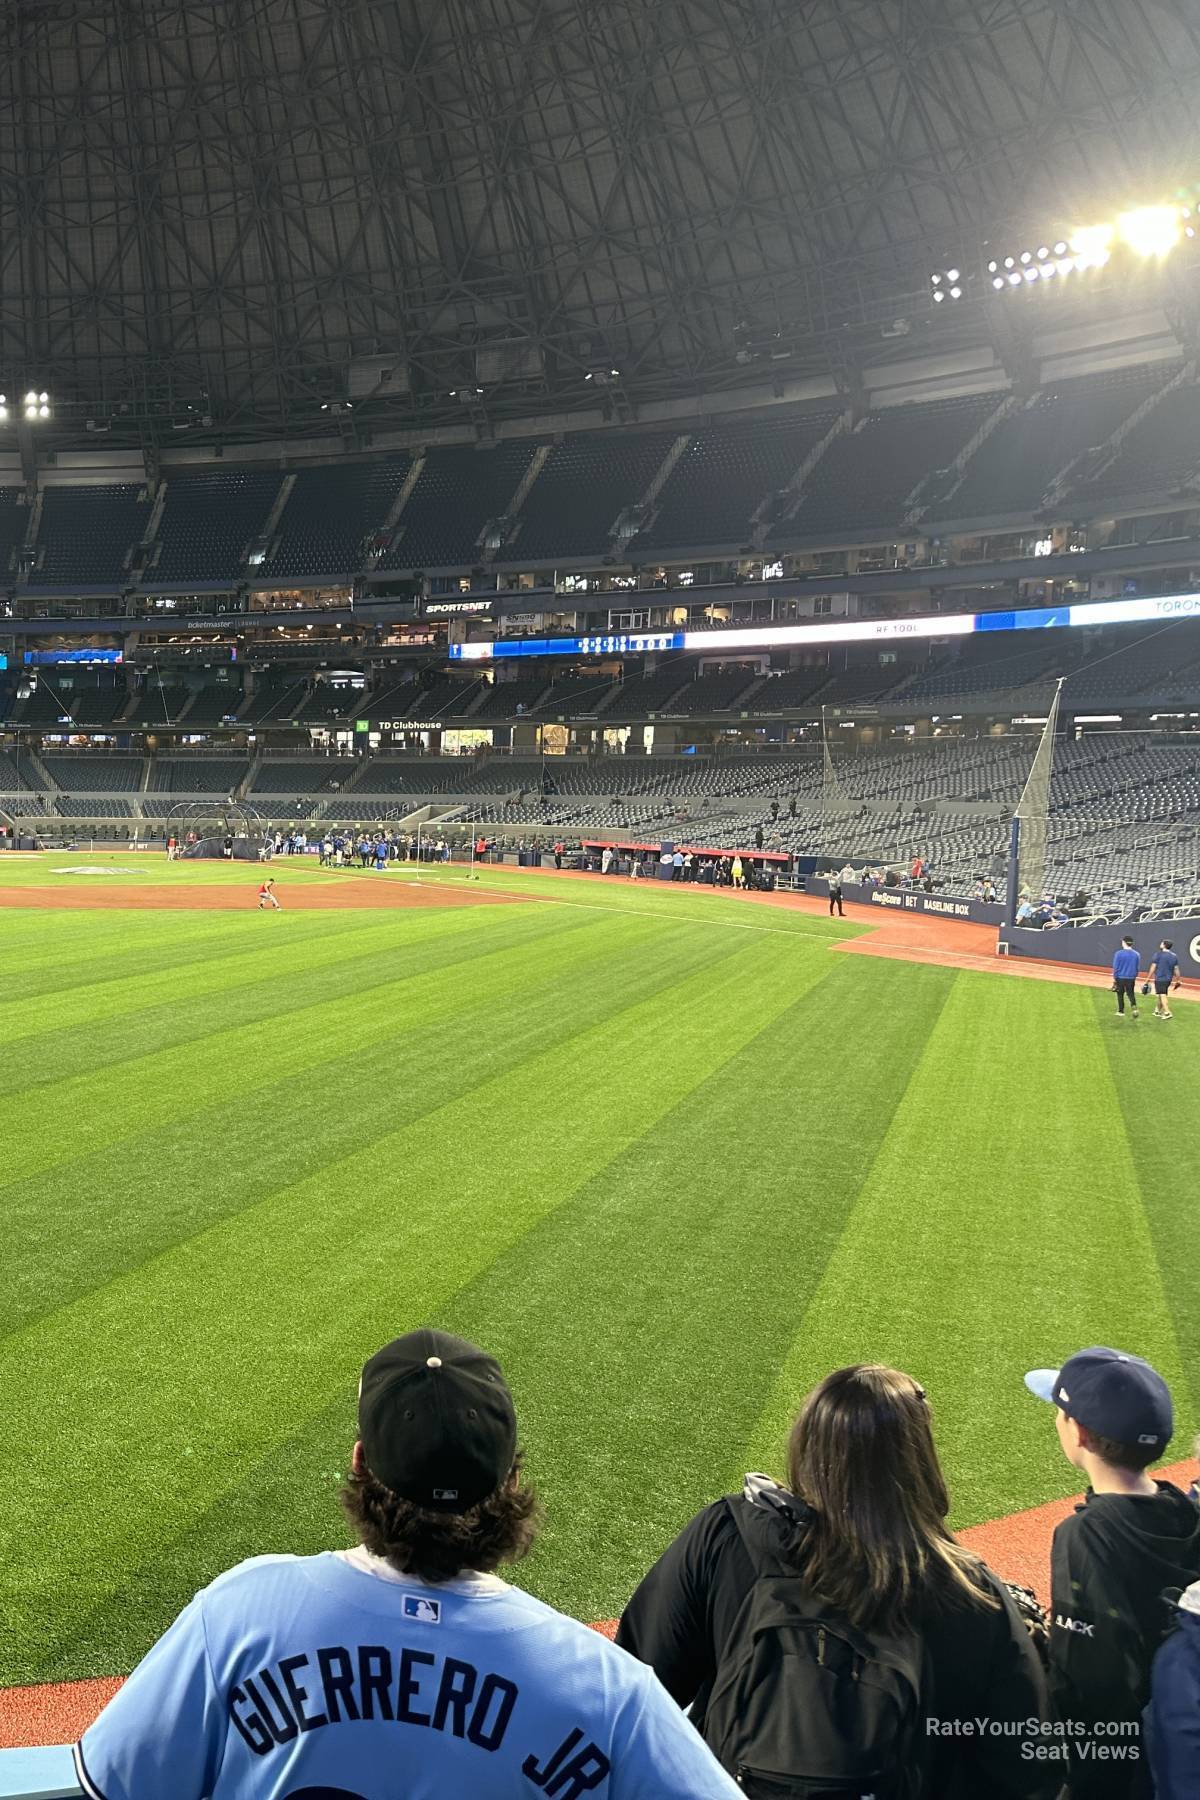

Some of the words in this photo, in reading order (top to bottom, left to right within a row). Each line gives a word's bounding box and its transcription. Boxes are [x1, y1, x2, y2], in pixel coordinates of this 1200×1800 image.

[426, 601, 492, 613] SPORTSNET
[906, 896, 918, 907] BET
[924, 900, 954, 914] BASELINE
[955, 904, 968, 915] BOX
[229, 1645, 519, 1756] GUERRERO
[522, 1727, 611, 1800] JR
